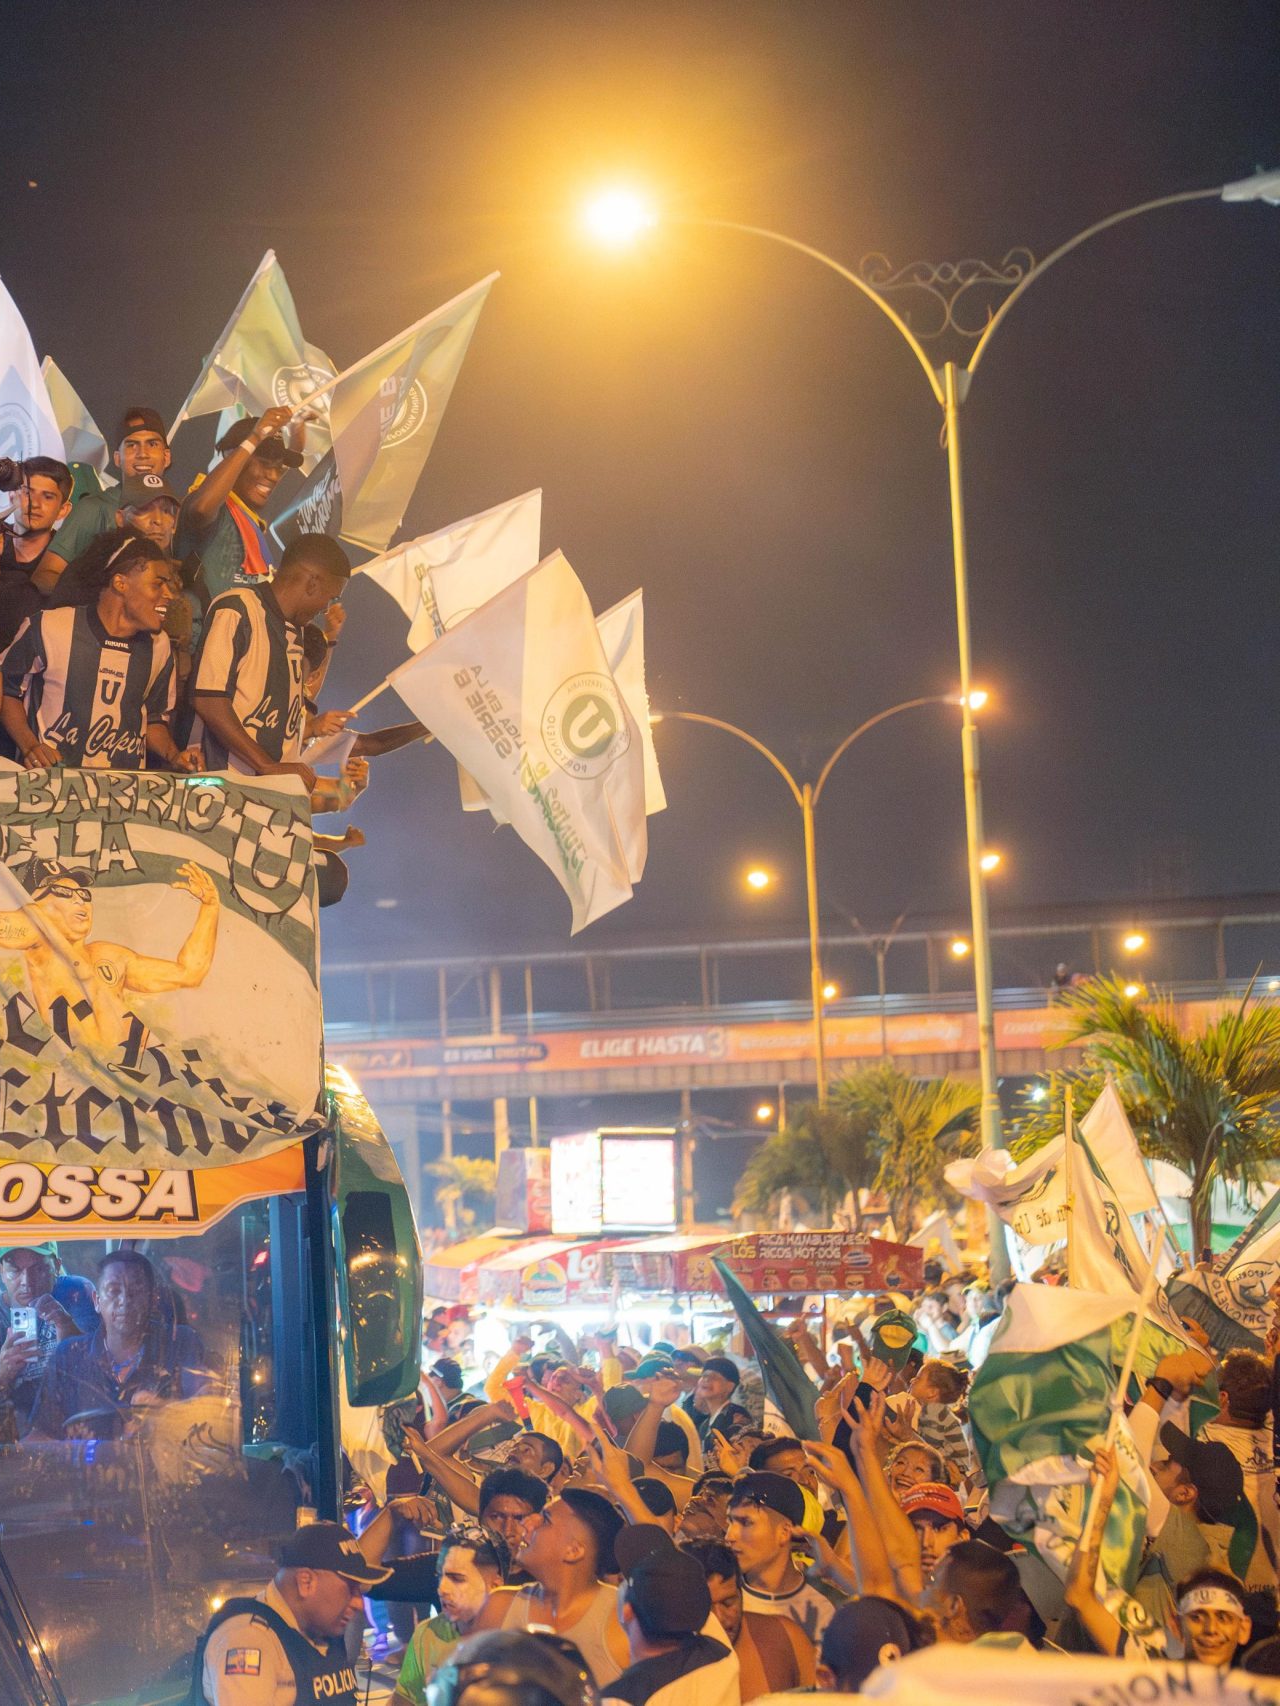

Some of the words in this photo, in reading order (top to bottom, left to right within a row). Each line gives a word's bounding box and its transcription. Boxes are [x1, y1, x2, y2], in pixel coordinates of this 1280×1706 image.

[101, 679, 122, 705] U
[46, 712, 78, 744] La
[244, 695, 280, 730] La
[14, 767, 230, 833] BARRIO
[56, 816, 142, 877] LA
[227, 793, 314, 917] U
[579, 1036, 634, 1057] ELIGE
[637, 1033, 705, 1056] HASTA
[707, 1027, 726, 1057] 3
[732, 1245, 757, 1259] LOS
[759, 1247, 793, 1260] RICOS
[793, 1246, 842, 1259] HOT-DOG
[786, 1233, 871, 1247] HAMBURGUESA
[312, 1667, 358, 1700] POLICIA
